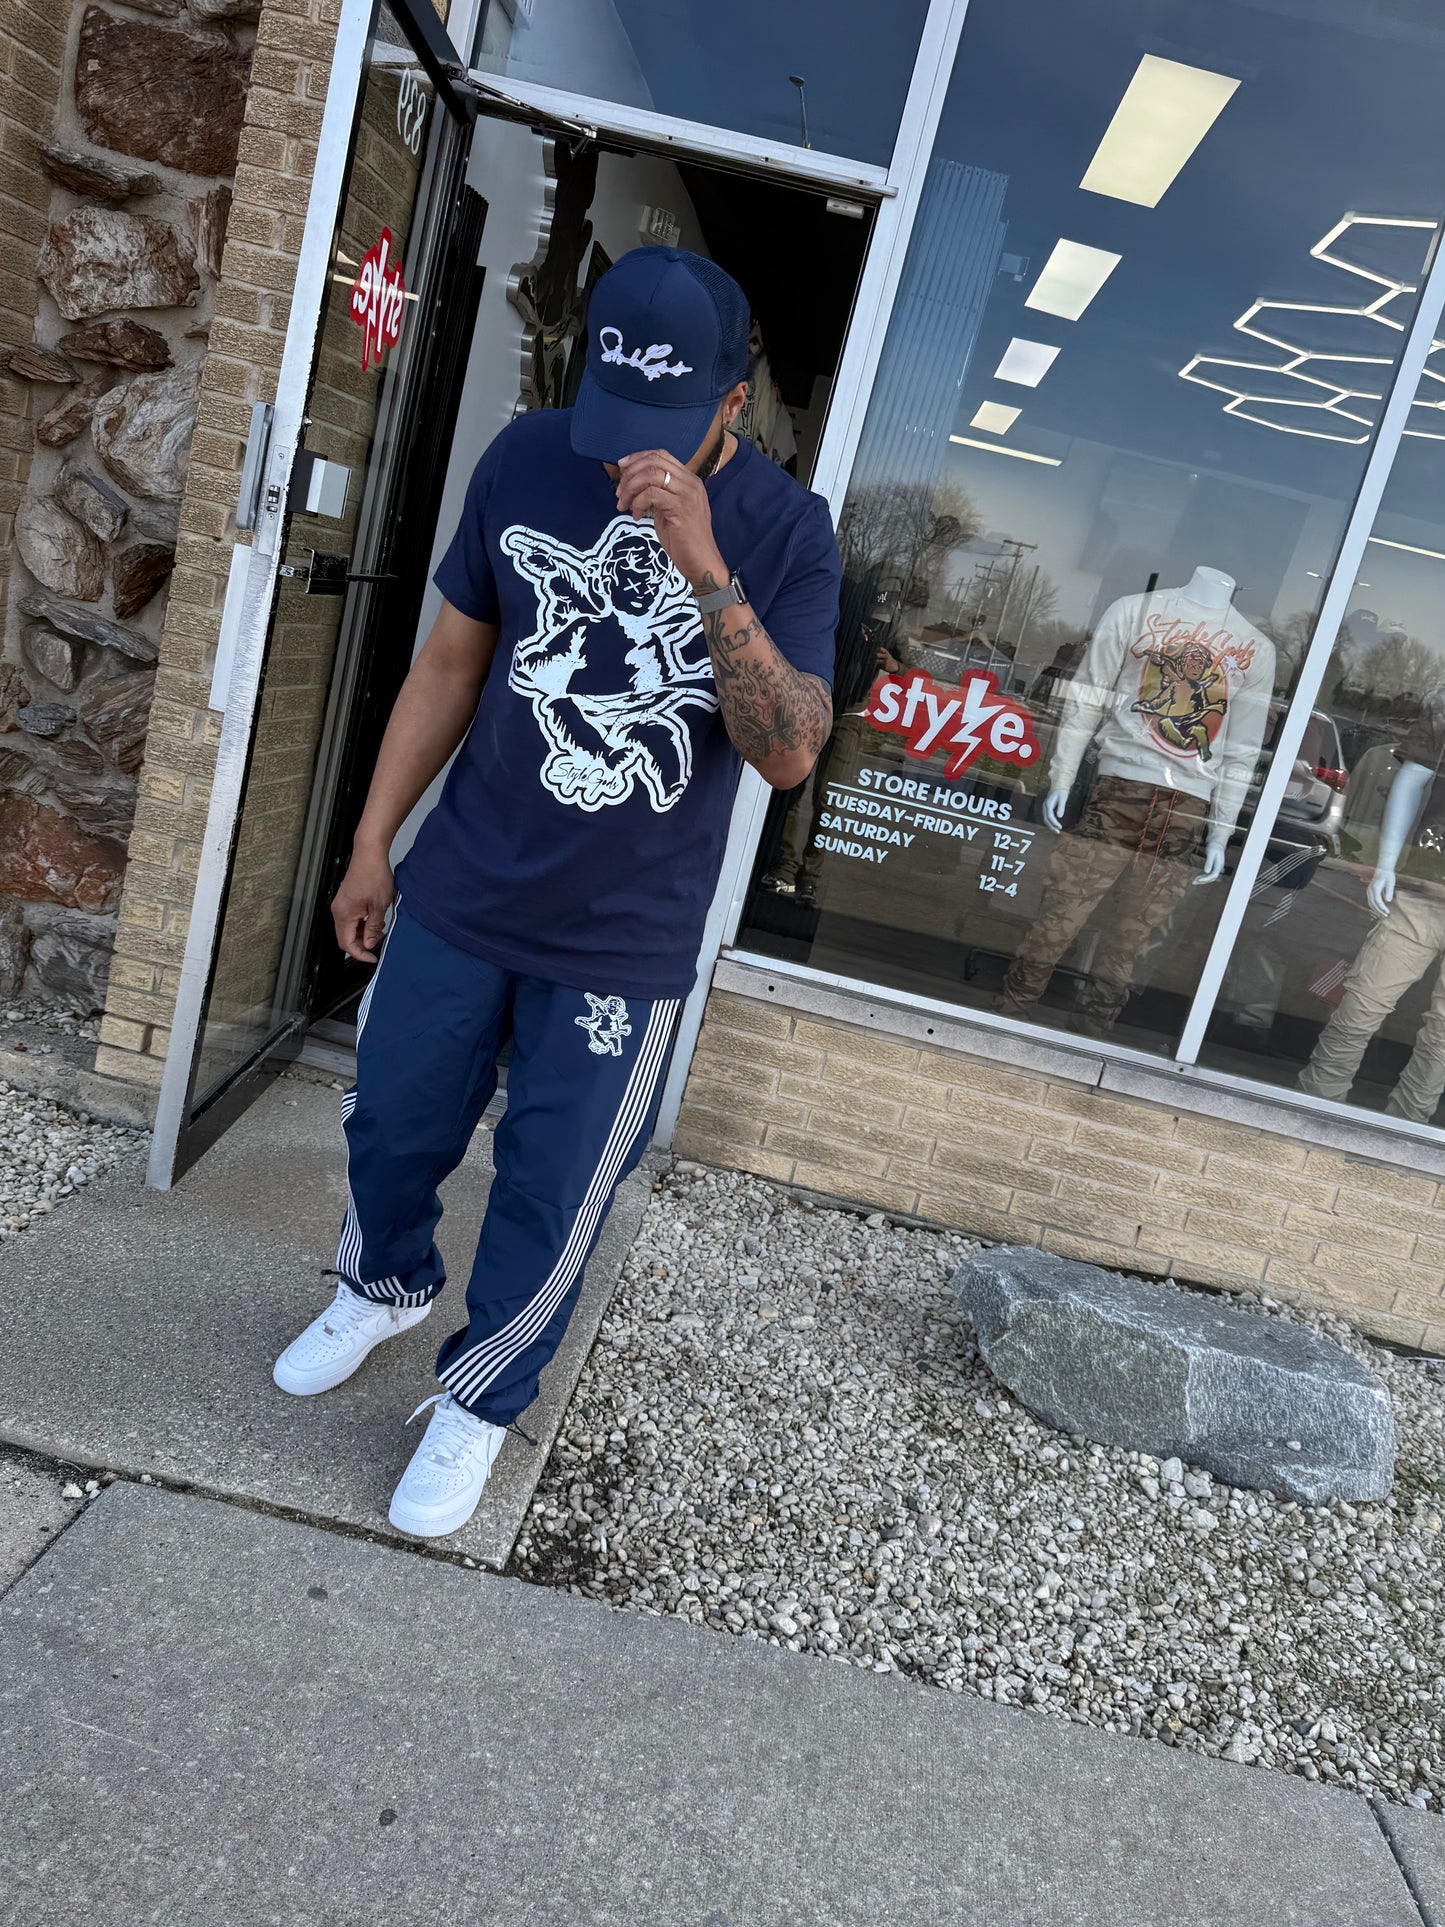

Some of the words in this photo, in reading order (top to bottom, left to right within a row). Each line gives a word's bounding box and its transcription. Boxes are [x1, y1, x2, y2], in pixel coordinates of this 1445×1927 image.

[825, 790, 979, 841] TUESDAY-FRIDAY
[993, 832, 1032, 854] 12-7
[858, 768, 930, 801] STORE
[933, 787, 1013, 821] HOURS
[813, 833, 888, 864] SUNDAY
[978, 874, 1018, 898] 12-4
[819, 812, 916, 848] SATURDAY
[990, 854, 1026, 876] 11-7
